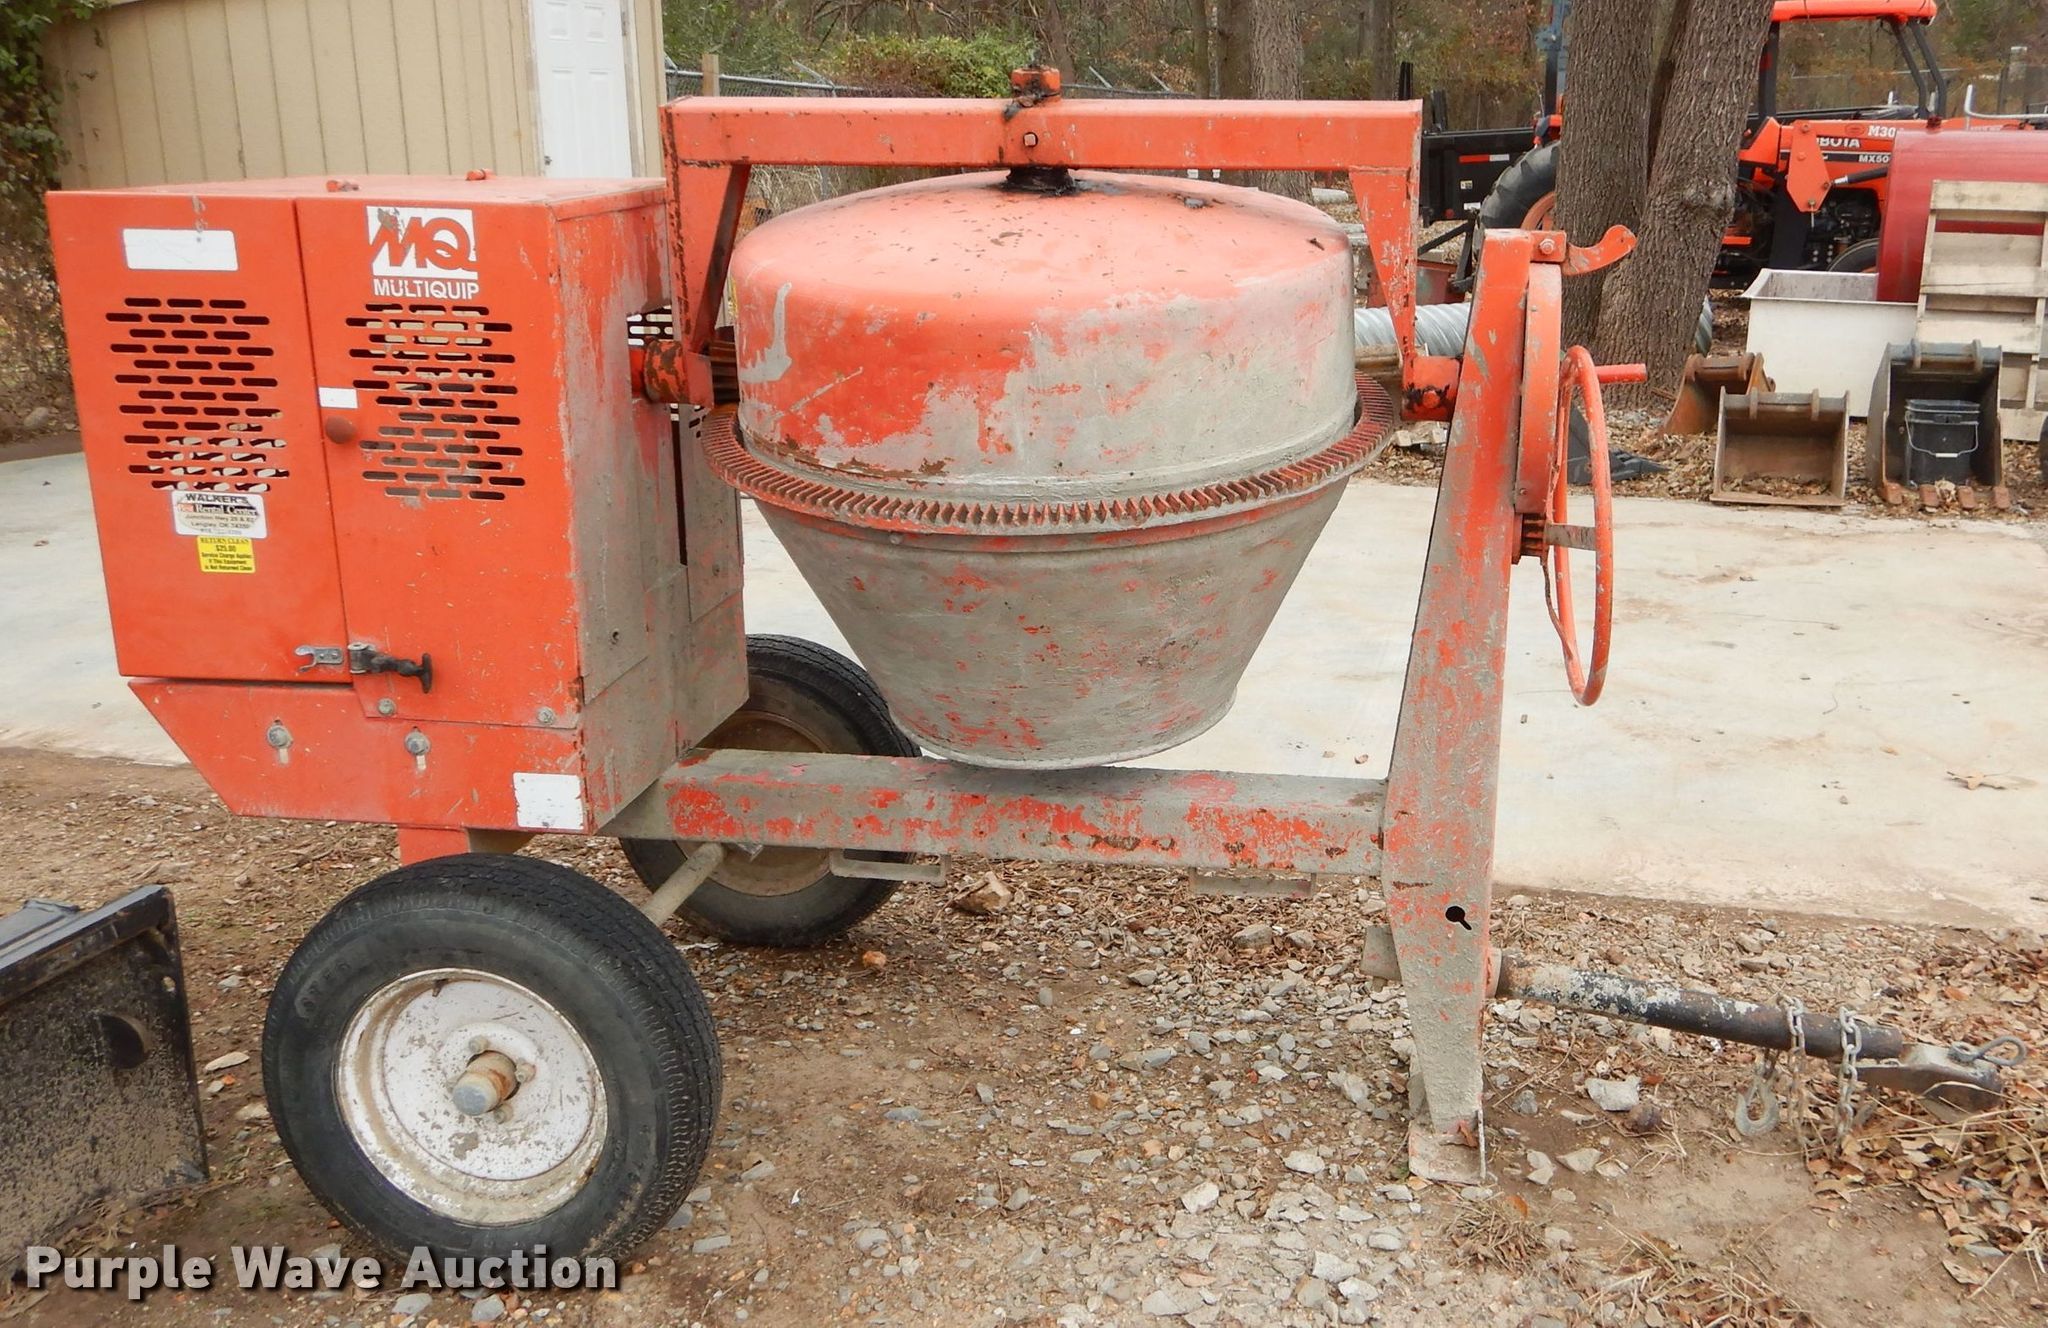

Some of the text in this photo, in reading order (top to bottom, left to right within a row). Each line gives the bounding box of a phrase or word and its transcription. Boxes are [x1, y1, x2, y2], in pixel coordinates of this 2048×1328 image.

[1816, 137, 1861, 148] BOTA
[368, 214, 477, 271] MQ
[373, 278, 480, 300] MULTIQUIP
[185, 493, 249, 505] WALKER'S
